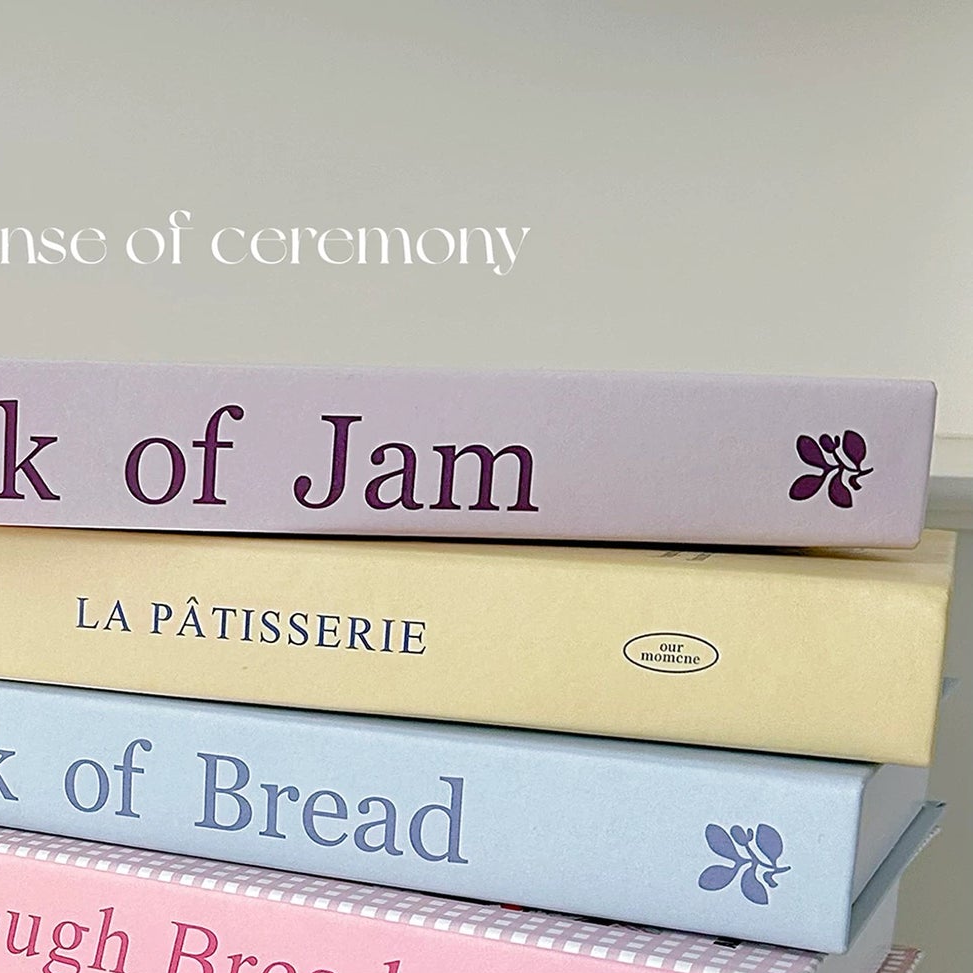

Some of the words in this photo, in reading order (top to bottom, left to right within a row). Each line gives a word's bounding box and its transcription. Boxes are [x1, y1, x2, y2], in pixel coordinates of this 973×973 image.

[124, 405, 244, 506] of
[293, 415, 538, 512] Jam
[76, 596, 130, 633] LA
[149, 596, 429, 656] PÂTISSERIE
[659, 643, 684, 653] our
[64, 738, 154, 818] of
[195, 752, 469, 864] Bread
